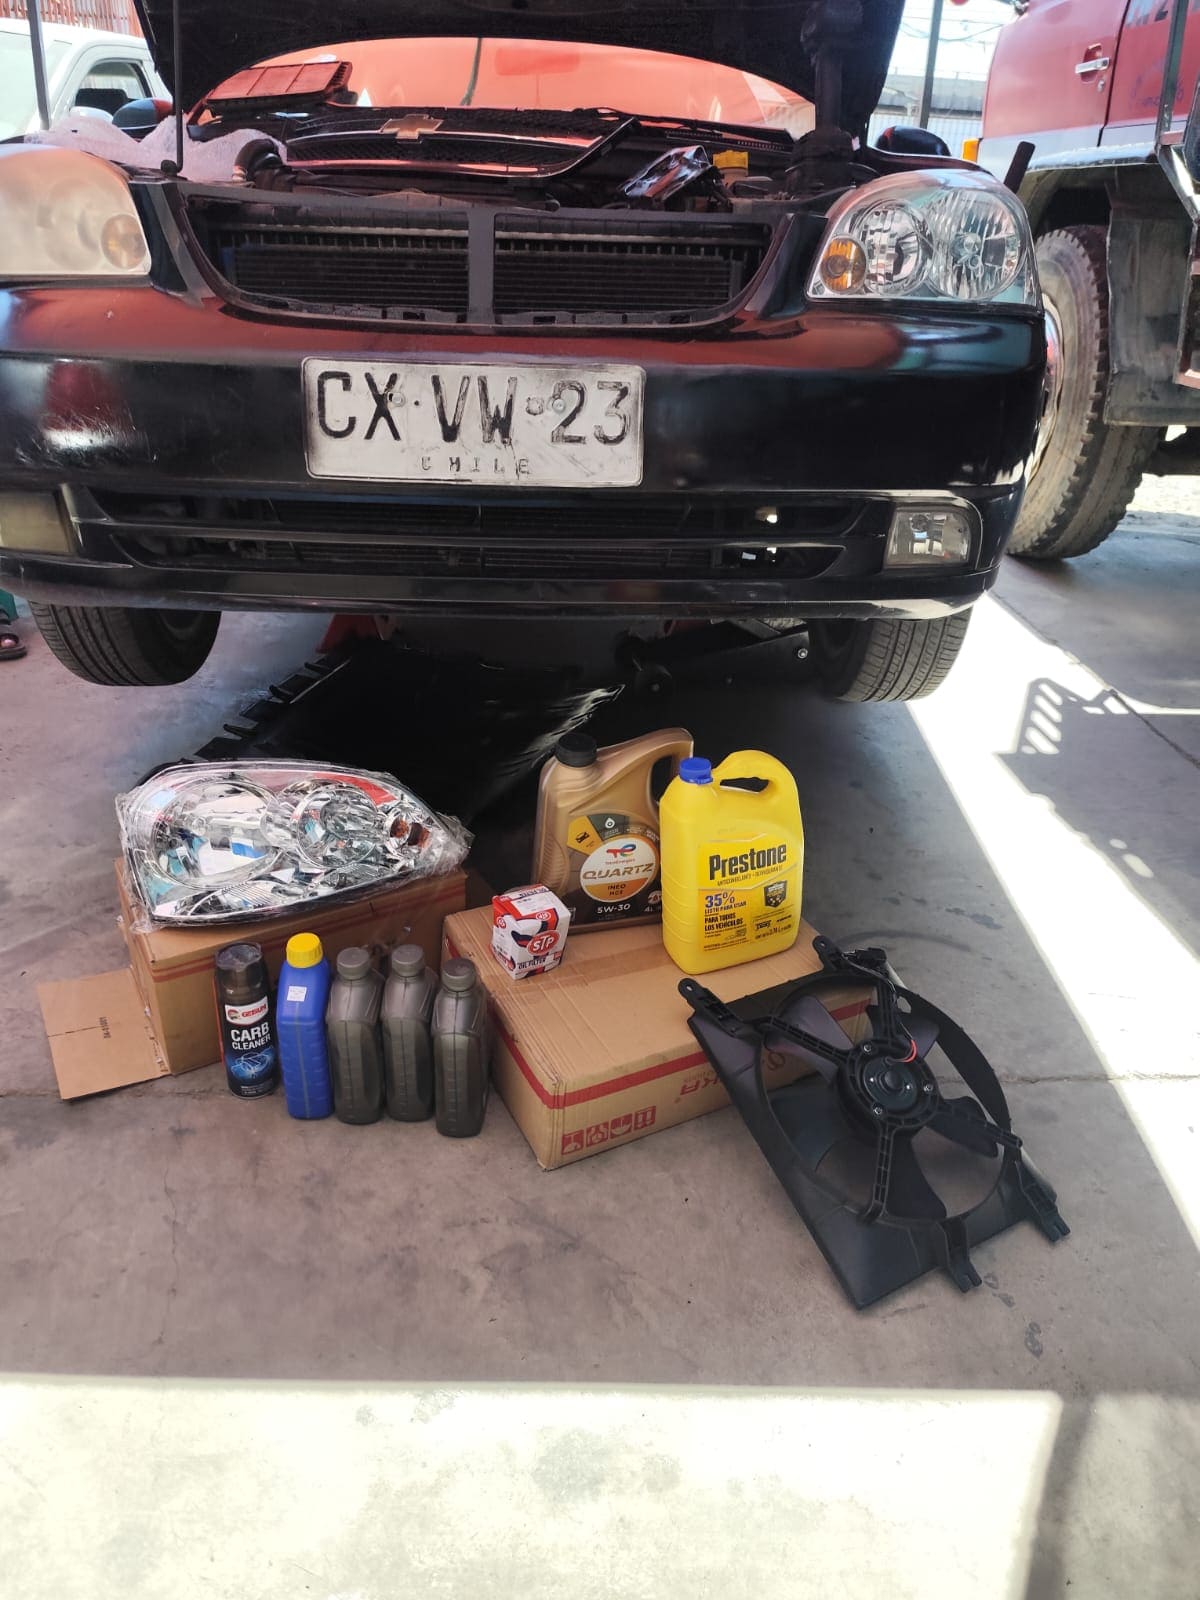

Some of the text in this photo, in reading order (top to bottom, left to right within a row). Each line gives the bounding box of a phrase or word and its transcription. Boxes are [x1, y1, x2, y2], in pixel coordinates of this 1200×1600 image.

[421, 456, 531, 476] CHILE
[709, 844, 787, 880] Prestone
[582, 863, 654, 880] QUARTZ
[705, 890, 735, 908] 35%
[597, 903, 631, 914] 5W-30
[705, 915, 719, 923] PARA
[705, 923, 715, 931] LOS
[533, 935, 554, 951] STP
[231, 1022, 270, 1042] CARB
[232, 1033, 271, 1051] CLEANER
